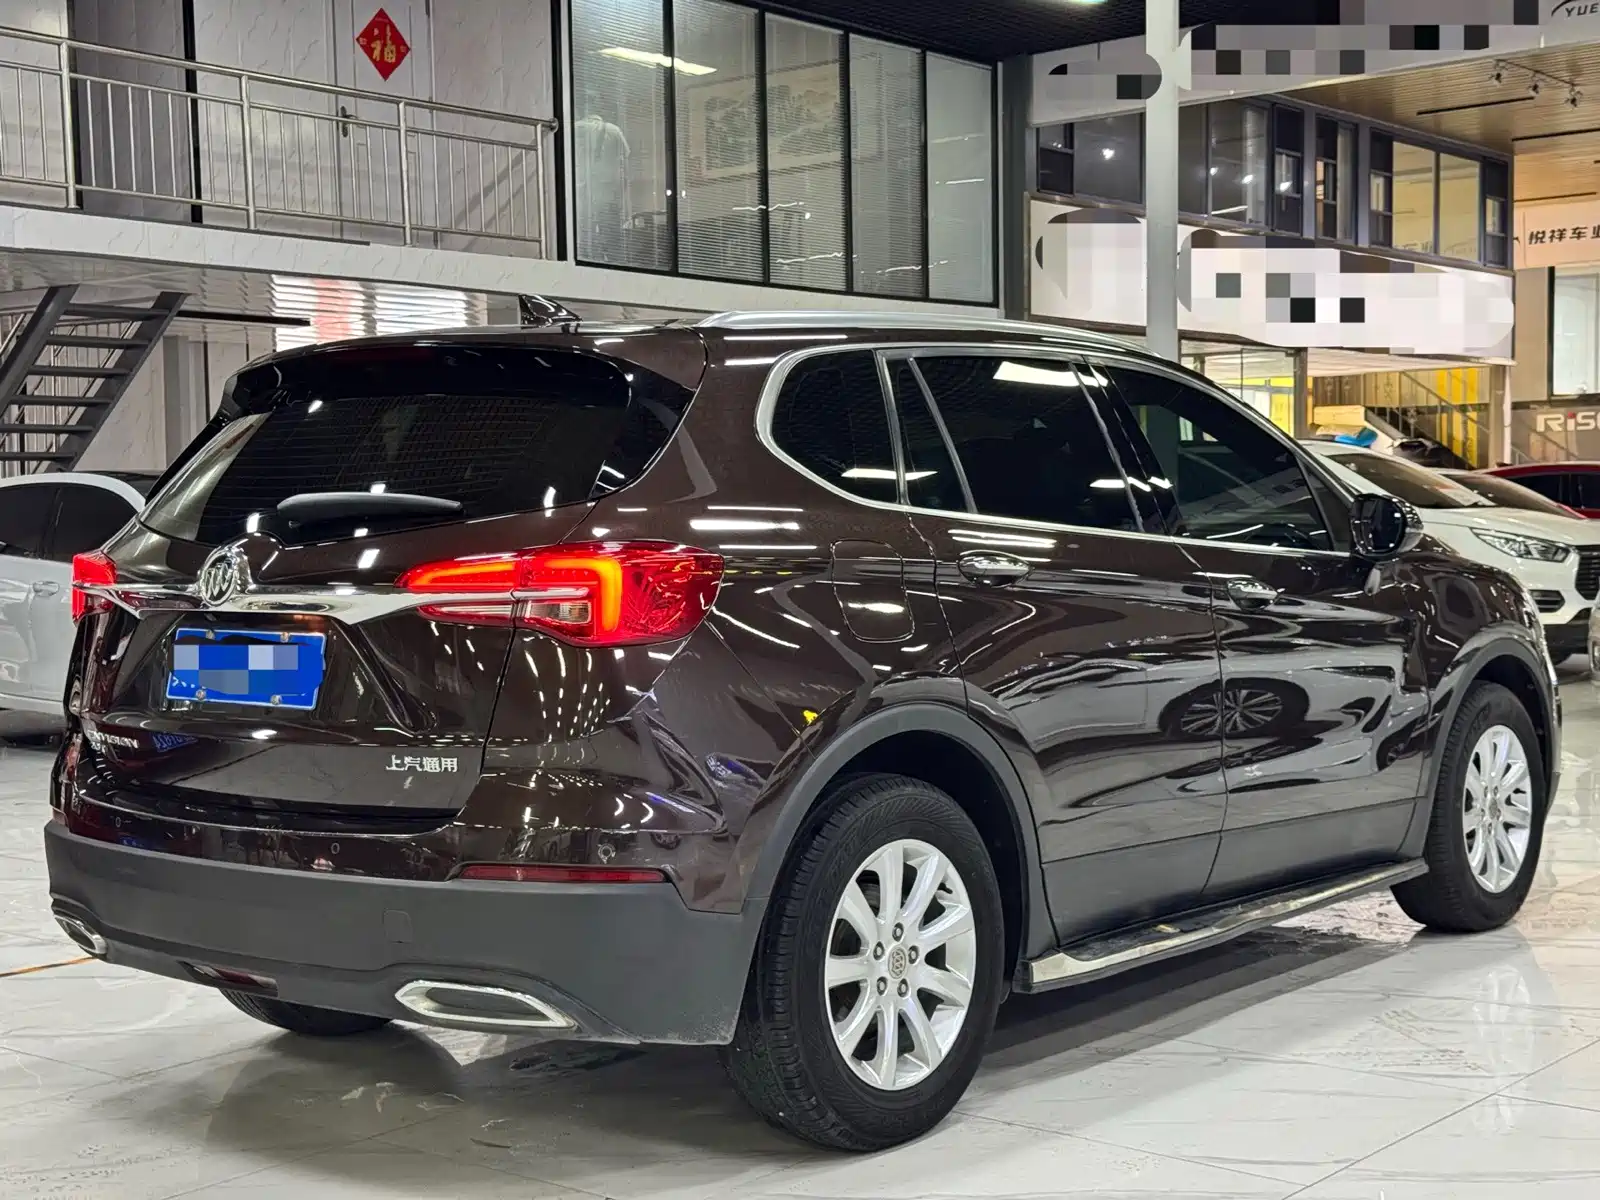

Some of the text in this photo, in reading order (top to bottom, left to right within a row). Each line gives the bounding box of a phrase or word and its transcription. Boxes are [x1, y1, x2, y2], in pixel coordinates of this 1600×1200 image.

[370, 23, 397, 63] 福
[385, 754, 458, 773] 上汽通用
